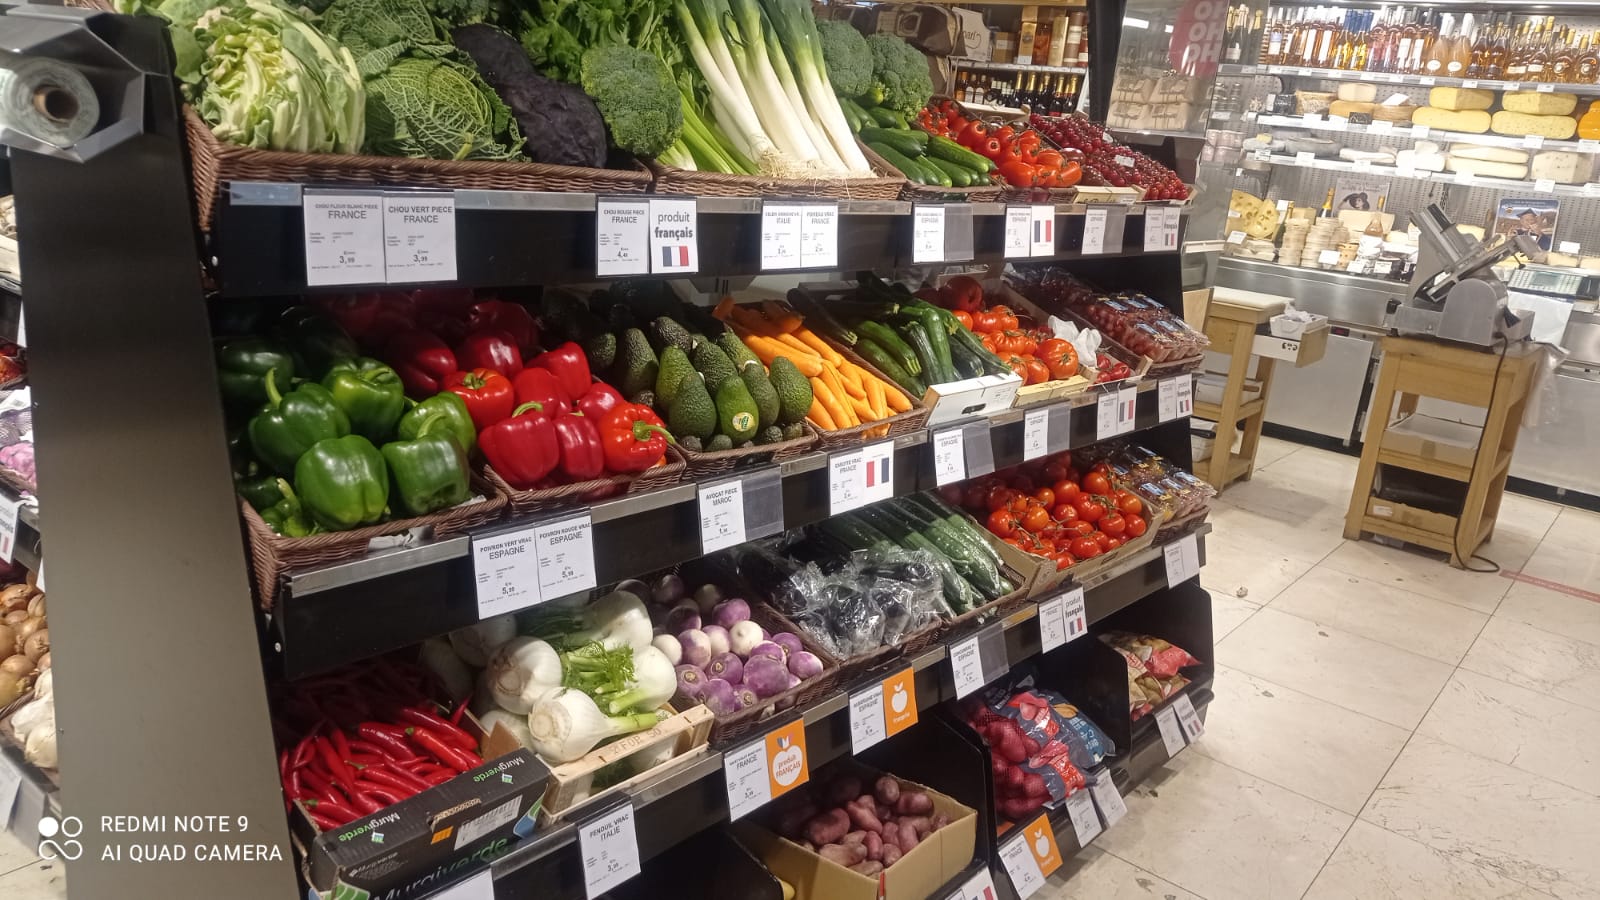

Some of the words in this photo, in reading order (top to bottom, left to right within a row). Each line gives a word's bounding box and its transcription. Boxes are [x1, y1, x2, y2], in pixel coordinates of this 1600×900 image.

[328, 210, 367, 219] FRANCE
[403, 215, 439, 223] FRANCE
[611, 216, 638, 224] FRANCE
[658, 212, 690, 224] produit
[654, 226, 693, 240] français
[705, 490, 724, 500] AVOCAT
[724, 487, 738, 496] PIECE
[712, 495, 732, 506] MAROC
[539, 529, 561, 540] POIVRON
[560, 525, 578, 534] ROUGE
[550, 531, 583, 546] ESPAGNE
[480, 543, 504, 553] POIVRON
[518, 536, 532, 545] VRAC
[488, 545, 525, 560] ESPAGNE
[472, 756, 526, 783] Murgiverde
[337, 811, 401, 843] Murgiverde
[589, 823, 613, 838] FENOUIL
[613, 814, 629, 825] VRAC
[600, 826, 621, 841] ITALIE
